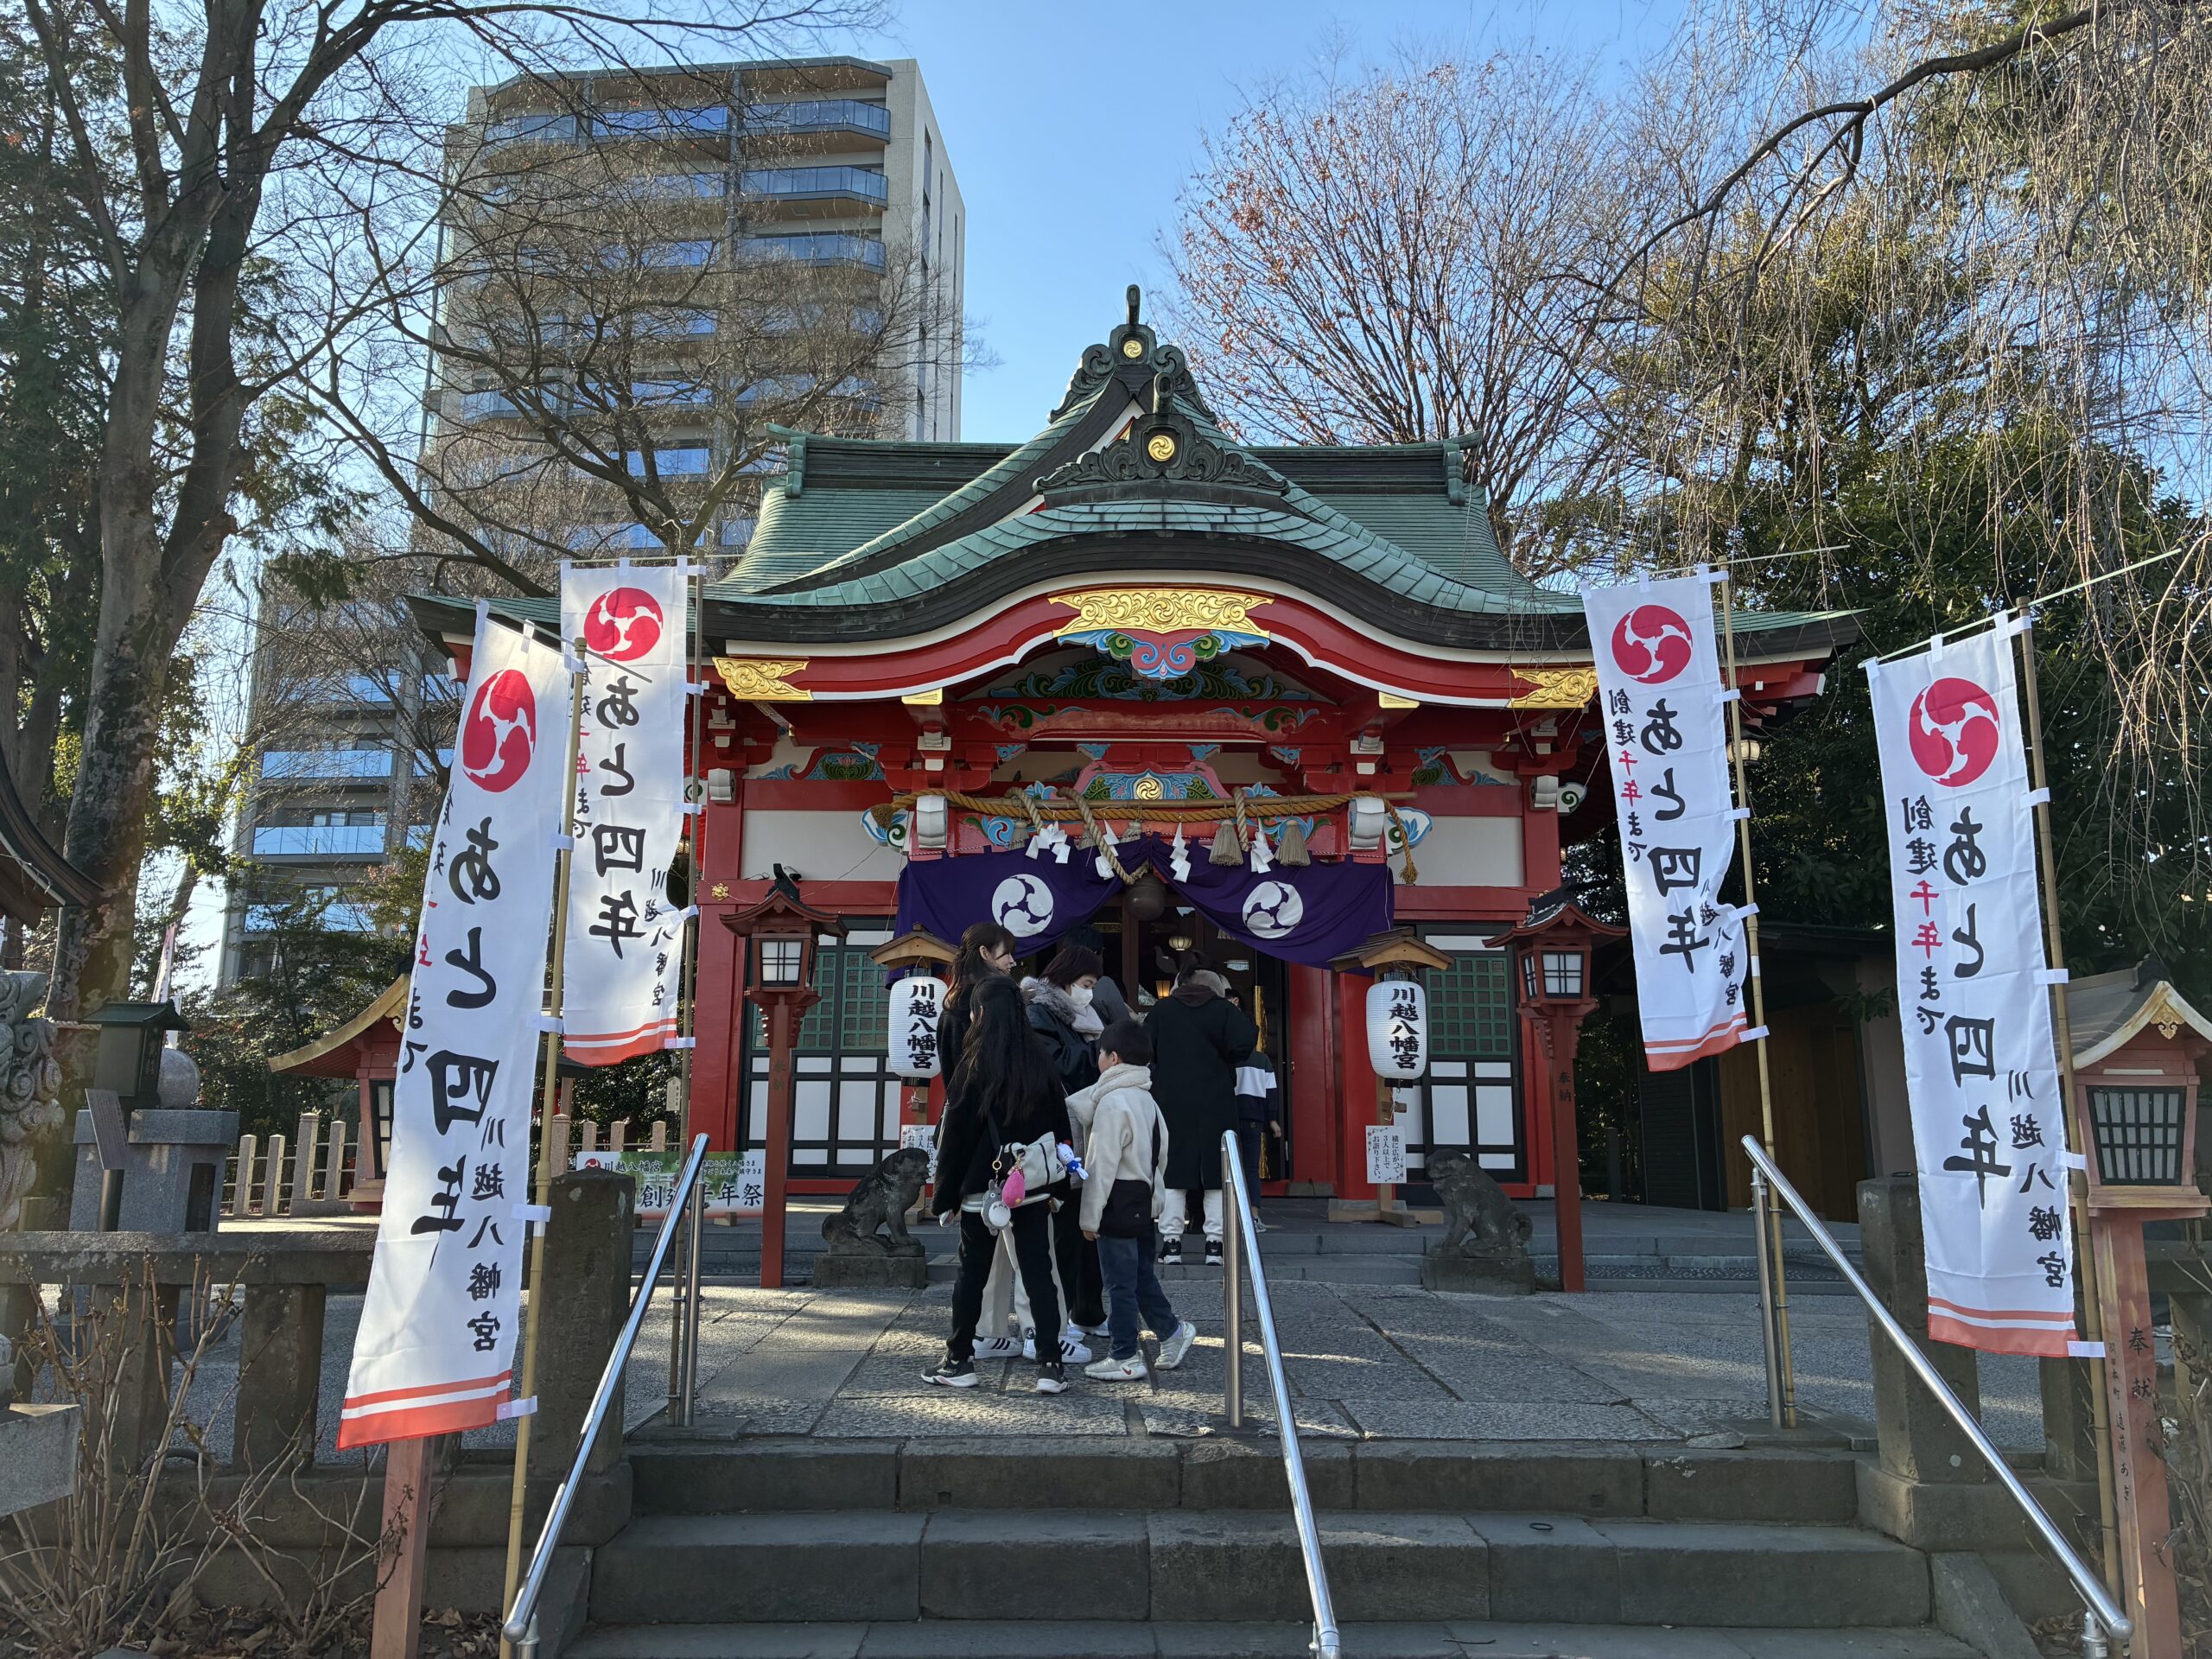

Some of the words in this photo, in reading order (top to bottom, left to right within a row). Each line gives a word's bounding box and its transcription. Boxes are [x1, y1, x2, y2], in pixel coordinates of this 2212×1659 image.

[907, 984, 937, 1069] 川越八幡宮
[1389, 987, 1420, 1070] 川越八幡宮
